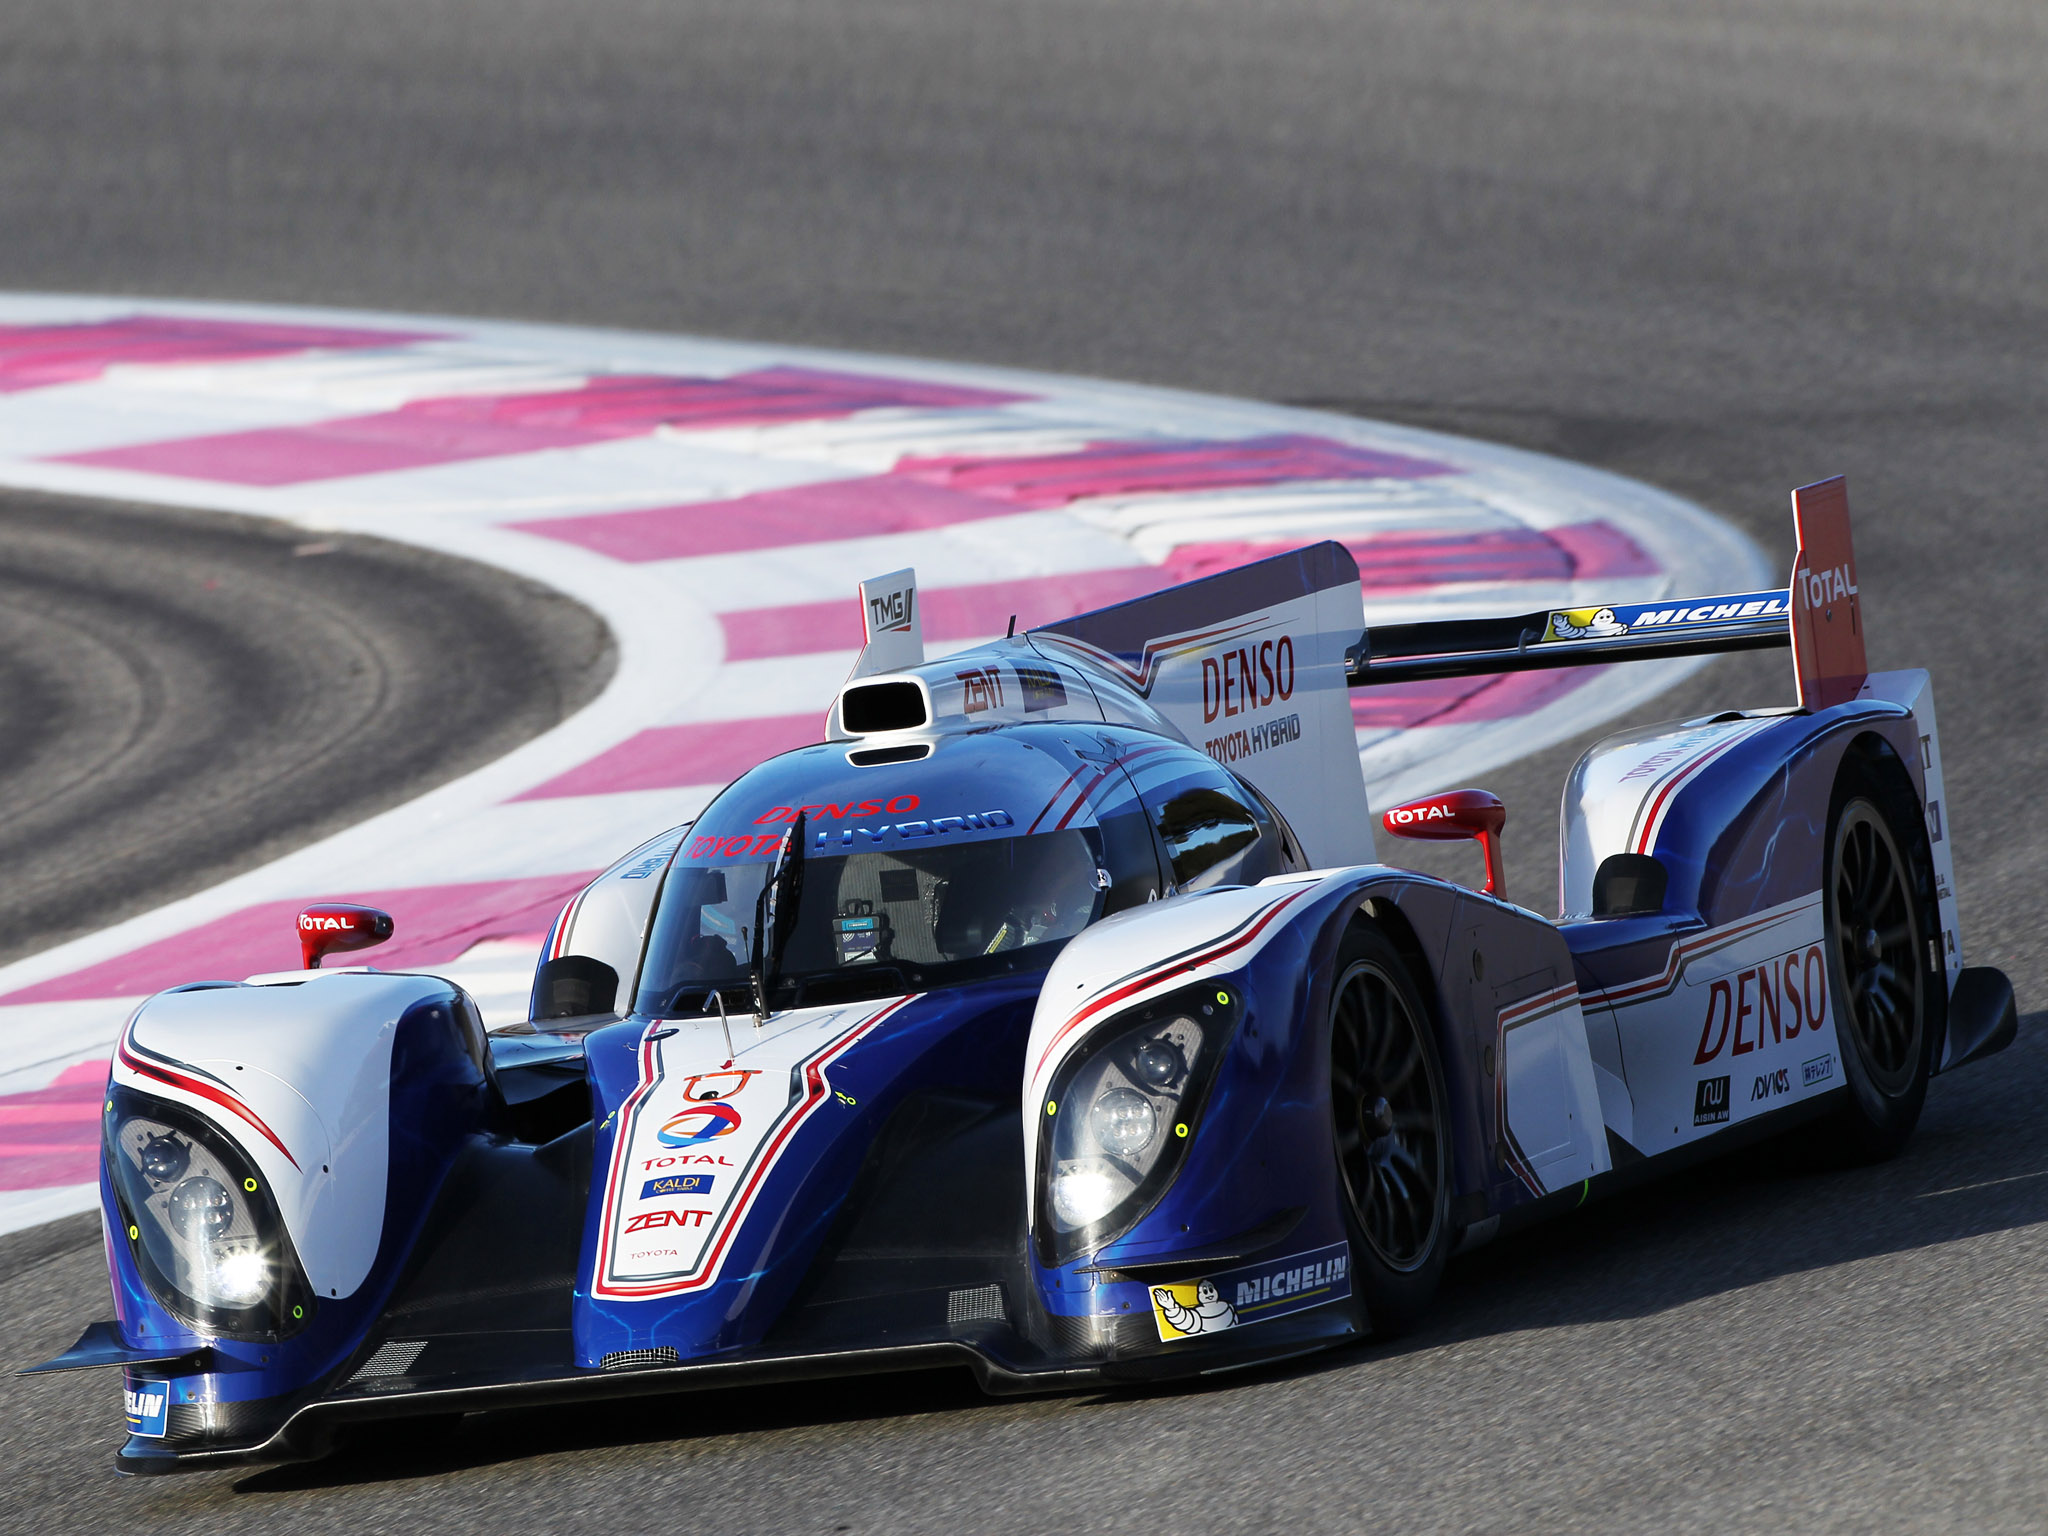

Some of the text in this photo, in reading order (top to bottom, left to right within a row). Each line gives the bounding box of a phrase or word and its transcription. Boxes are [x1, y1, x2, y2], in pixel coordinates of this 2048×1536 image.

[1798, 563, 1858, 611] TOTAL
[954, 664, 1005, 715] ZENT
[1201, 635, 1294, 724] DENSO
[1205, 713, 1301, 764] TOYOTA HYBRID
[752, 795, 920, 825] DENSO
[1387, 805, 1456, 825] TOTAL
[684, 810, 1015, 860] TOYOTA HYBRID
[299, 913, 355, 931] TOTAL
[1693, 945, 1826, 1065] DENSO
[1750, 1067, 1790, 1102] ADVICS
[1694, 1109, 1730, 1124] AISIN AW
[640, 1154, 735, 1171] TOTAL
[652, 1177, 701, 1191] KALDI
[624, 1209, 713, 1235] ZENT
[630, 1249, 679, 1260] TOYOTA
[1236, 1255, 1348, 1306] MICHELIN
